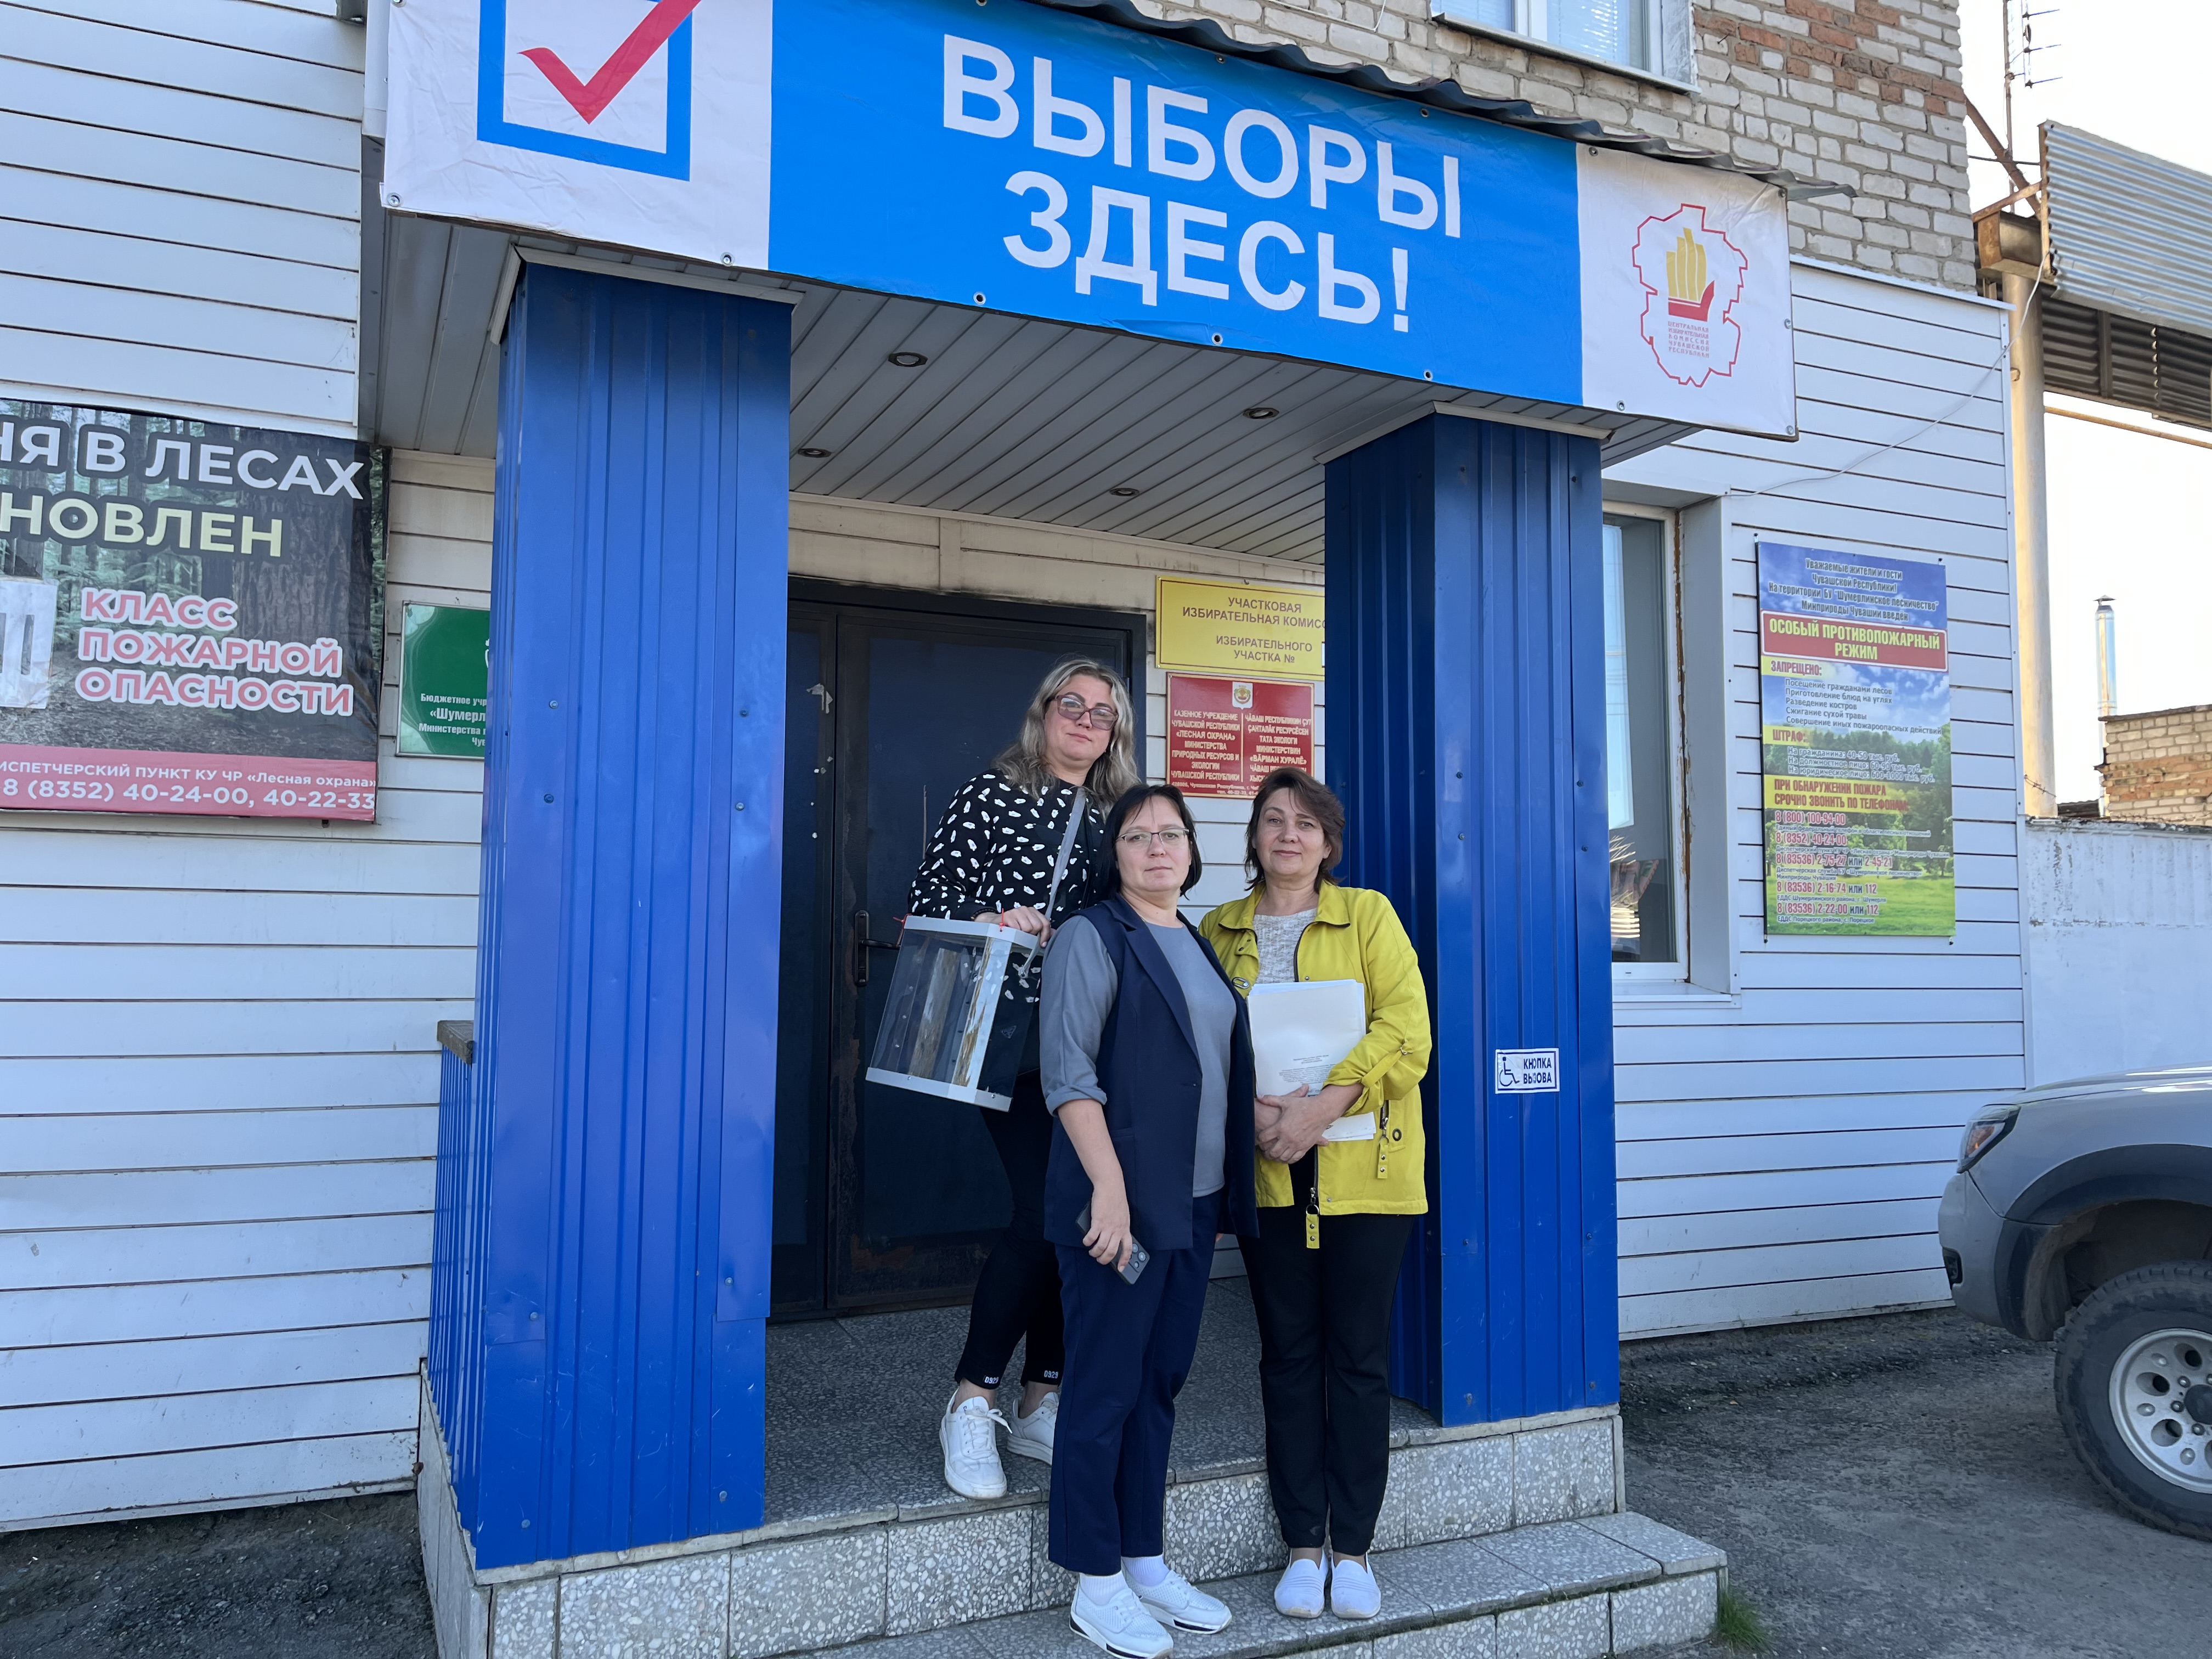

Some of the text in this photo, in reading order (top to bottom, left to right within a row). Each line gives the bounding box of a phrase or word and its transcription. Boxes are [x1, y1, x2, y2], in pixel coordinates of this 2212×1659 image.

[943, 33, 1461, 238] ВЫБОРЫ
[1003, 170, 1408, 332] ЗДЕСЬ!
[1668, 321, 1709, 332] ЦЕНТРАЛЬНАЯ
[1668, 334, 1709, 345] КОМИССИЯ
[1668, 340, 1709, 352] ЧУВАШСКОЙ
[1668, 347, 1709, 358] РЕСПУБЛИКИ
[86, 431, 126, 472] В
[145, 438, 365, 500] ЛЕСАХ
[0, 491, 283, 557] НОВЛЕН
[1805, 558, 1903, 580] Уважаемые жители и гости
[1812, 573, 1897, 592] Чувашской Республики!
[1769, 582, 1778, 592] На
[1779, 584, 1821, 597] территории
[1824, 589, 1832, 599] БУ
[83, 590, 238, 629] КЛАСС
[1228, 596, 1301, 613] УЧАСТКОВАЯ
[1801, 600, 1881, 618] Минприроды Чувашии
[1183, 606, 1280, 625] ИЗБИРАТЕЛЬНАЯ
[1769, 618, 1940, 650] ОСОБЫЙ ПРОТИВОПОЖАРНЫЙ
[1216, 635, 1312, 652] ИЗБИРАТЕЛЬНОГО
[81, 629, 342, 675] ПОЖАРНОЙ
[1234, 650, 1295, 663] УЧАСТКА №
[1835, 642, 1878, 660] РЕЖИМ
[1771, 660, 1822, 676] ЗАПРЕЩЕНО:
[78, 669, 351, 714] ОПАСНОСТИ
[1785, 678, 1826, 689] Посещение
[1827, 684, 1871, 692] гражданами
[420, 693, 471, 704] Бюджетное
[1786, 687, 1841, 699] Приготовление
[1842, 692, 1861, 702] блюд
[1786, 697, 1858, 710] Разведение костров
[430, 707, 486, 723] «Шумерл
[1174, 709, 1238, 721] КАЗЕННОЕ УЧРЕЖДЕНИЕ
[1786, 706, 1822, 716] Сжигание
[1823, 710, 1844, 718] сухой
[419, 723, 481, 735] Министерства
[1171, 719, 1240, 731] ЧУВАШСКОЙ РЕСПУБЛИКИ
[1786, 716, 1831, 726] Совершение
[1853, 722, 1909, 732] пожароопасных
[1910, 725, 1942, 735] действий
[1176, 730, 1235, 741] «ЛЕСНАЯ ОХРАНА»
[1259, 735, 1298, 744] ТАТА ЭКОЛОГИ
[1773, 729, 1806, 742] ШТРАФ:
[1184, 740, 1227, 751] МИНИСТЕРСТВА
[1256, 745, 1301, 755] МИНИСТЕРСТВИН
[1172, 749, 1206, 760] ПРИРОДНЫХ
[1206, 752, 1234, 761] РЕСУРСОВ
[1787, 747, 1797, 755] На
[1799, 749, 1846, 758] гражданина:
[1847, 751, 1868, 759] 40-50
[1885, 753, 1900, 763] руб.
[1191, 761, 1220, 770] ЭКОЛОГИИ
[1799, 758, 1848, 767] должностное
[1870, 761, 1891, 770] 60-90
[1891, 764, 1906, 772] тыс.
[1907, 764, 1922, 774] руб.
[136, 766, 190, 780] ПУНКТ
[195, 770, 217, 780] КУ
[222, 771, 242, 781] ЧР
[247, 772, 311, 785] «Лесная
[316, 776, 376, 787] охрана»
[1171, 770, 1205, 780] ЧУВАШСКОЙ
[1205, 772, 1240, 781] РЕСПУБЛИКИ
[1800, 768, 1848, 777] юридическое
[1849, 770, 1870, 778] лицо:
[1871, 770, 1904, 781] 600-1000
[1904, 774, 1920, 782] тыс.
[1920, 774, 1936, 784] руб.
[3, 778, 375, 810] 8 (8352) 40-24-00, 40-22-33
[1774, 778, 1886, 796] ПРИ ОБНАРУЖЕНИИ ПОЖАРА
[1774, 793, 1807, 806] СРОЧНО
[1809, 795, 1845, 808] ЗВОНИТЬ
[1847, 797, 1858, 808] ПО
[1775, 811, 1846, 825] 8 (800) 100-94-00
[1776, 833, 1847, 845] 8 (8352) 40-24-00
[1776, 854, 1892, 867] 8 (83536) 2-75-27 2-45-21
[1777, 882, 1877, 894] 8 (83536) 2-16-74 112
[1777, 902, 1879, 915] 8 (83536) 2-22-00 112
[1523, 1057, 1551, 1069] КНОПКА
[1043, 1370, 1059, 1379] 0929
